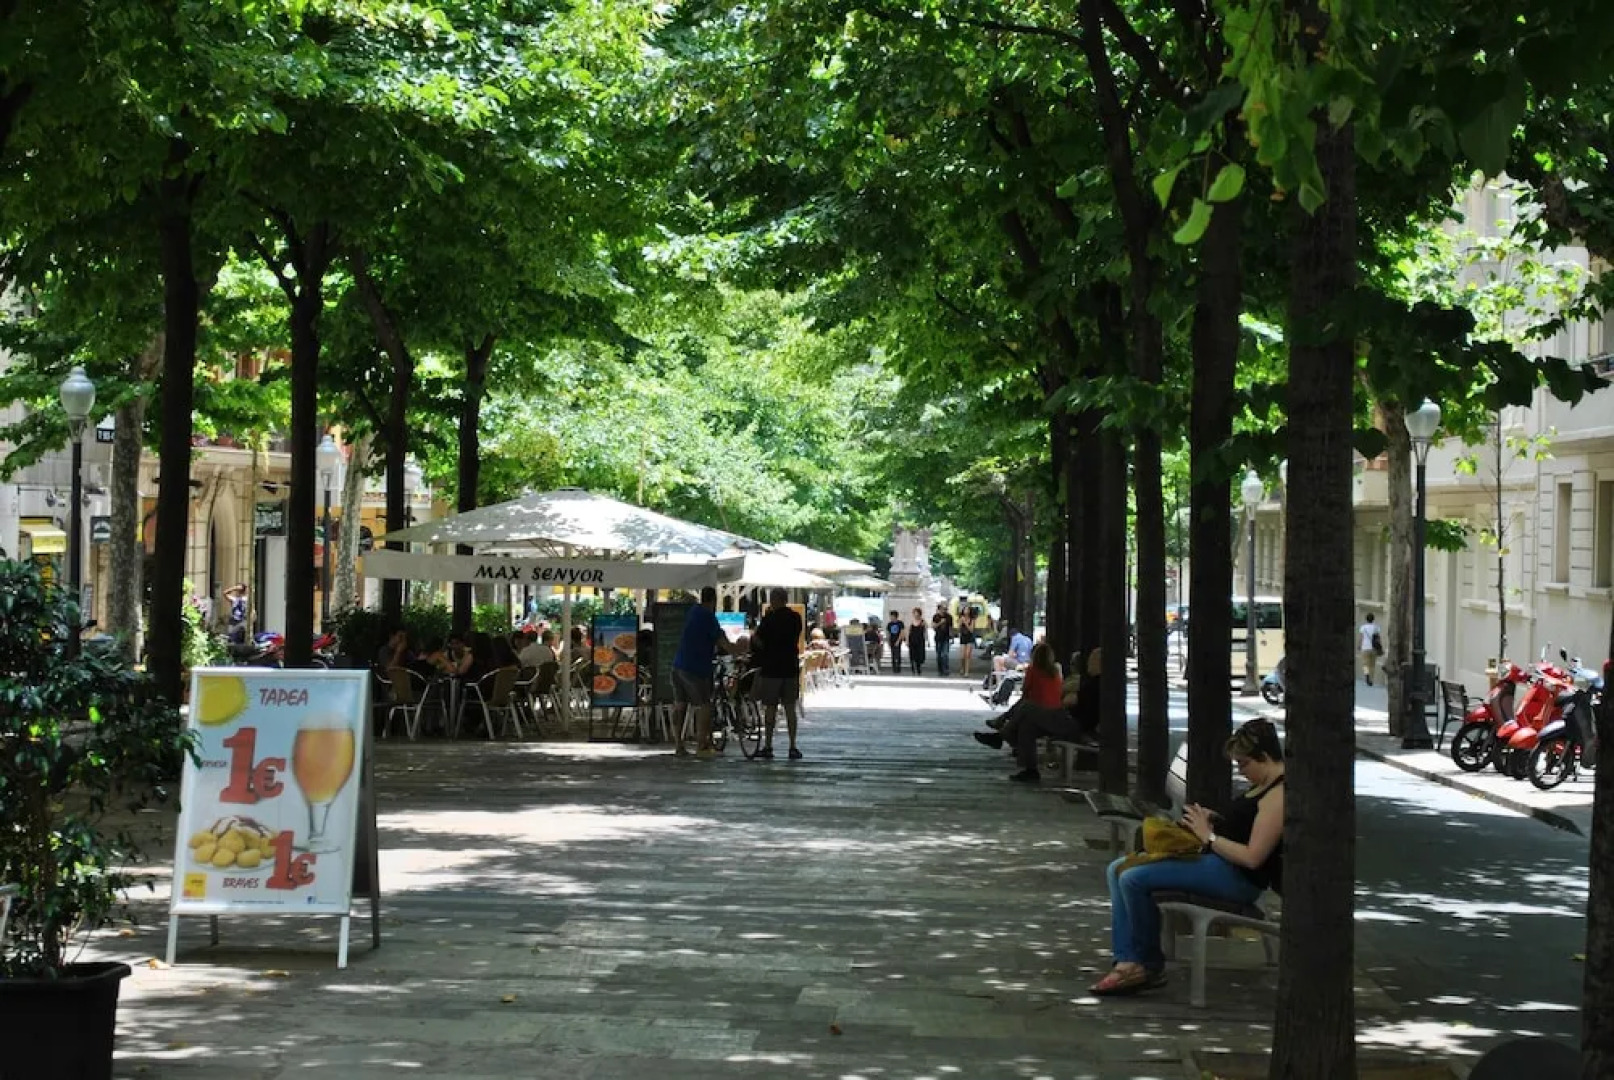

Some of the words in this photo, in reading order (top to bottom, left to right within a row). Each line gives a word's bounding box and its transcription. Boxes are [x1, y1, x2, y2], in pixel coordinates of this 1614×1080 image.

[475, 564, 521, 581] MAX
[259, 688, 309, 707] TAPEA
[219, 727, 286, 804] 1€
[266, 830, 317, 890] 1€
